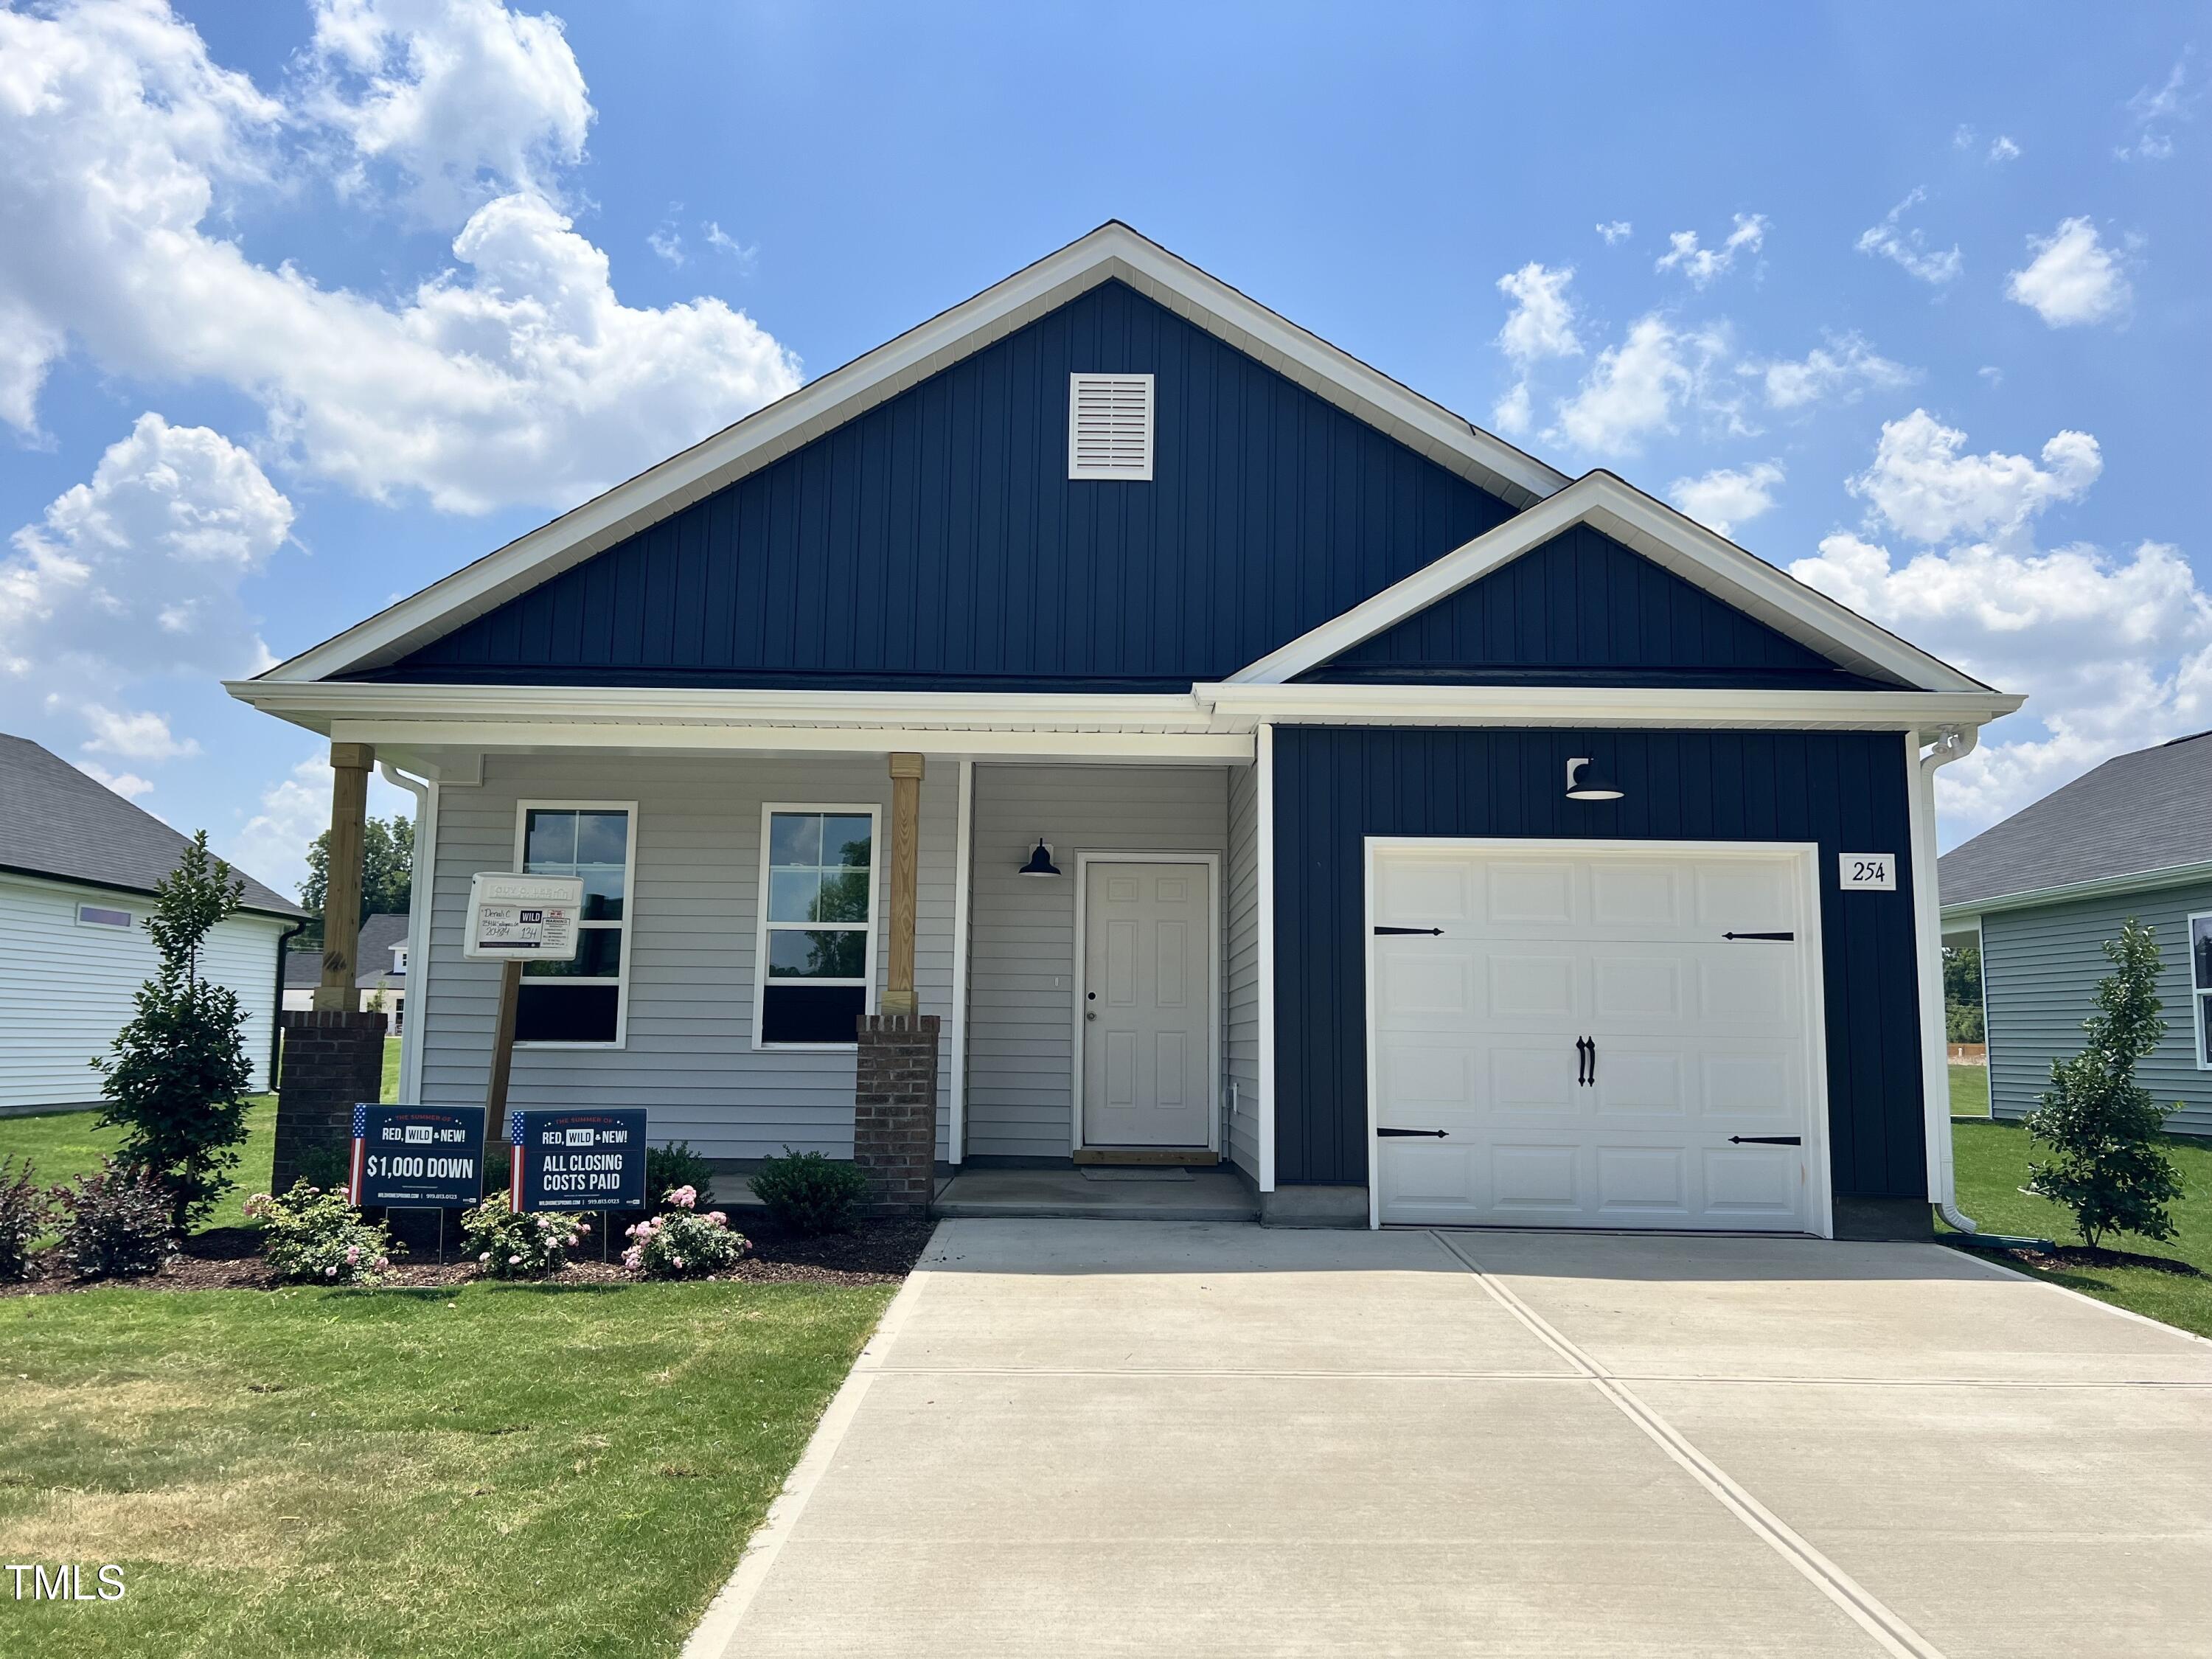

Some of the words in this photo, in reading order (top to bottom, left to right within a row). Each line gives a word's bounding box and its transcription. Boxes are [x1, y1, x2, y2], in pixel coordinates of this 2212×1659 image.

[1852, 861, 1885, 882] 254
[522, 912, 540, 922] WILD
[382, 1127, 404, 1142] RED,
[408, 1129, 430, 1141] WILD
[440, 1129, 466, 1142] NEW!
[542, 1132, 565, 1146] RED,
[569, 1132, 591, 1144] WILD
[602, 1130, 627, 1144] NEW!
[366, 1155, 423, 1179] $1,000
[427, 1158, 473, 1178] DOWN
[543, 1155, 567, 1172] ALL
[569, 1154, 622, 1171] CLOSING
[543, 1174, 585, 1191] COSTS
[589, 1173, 620, 1190] PAID
